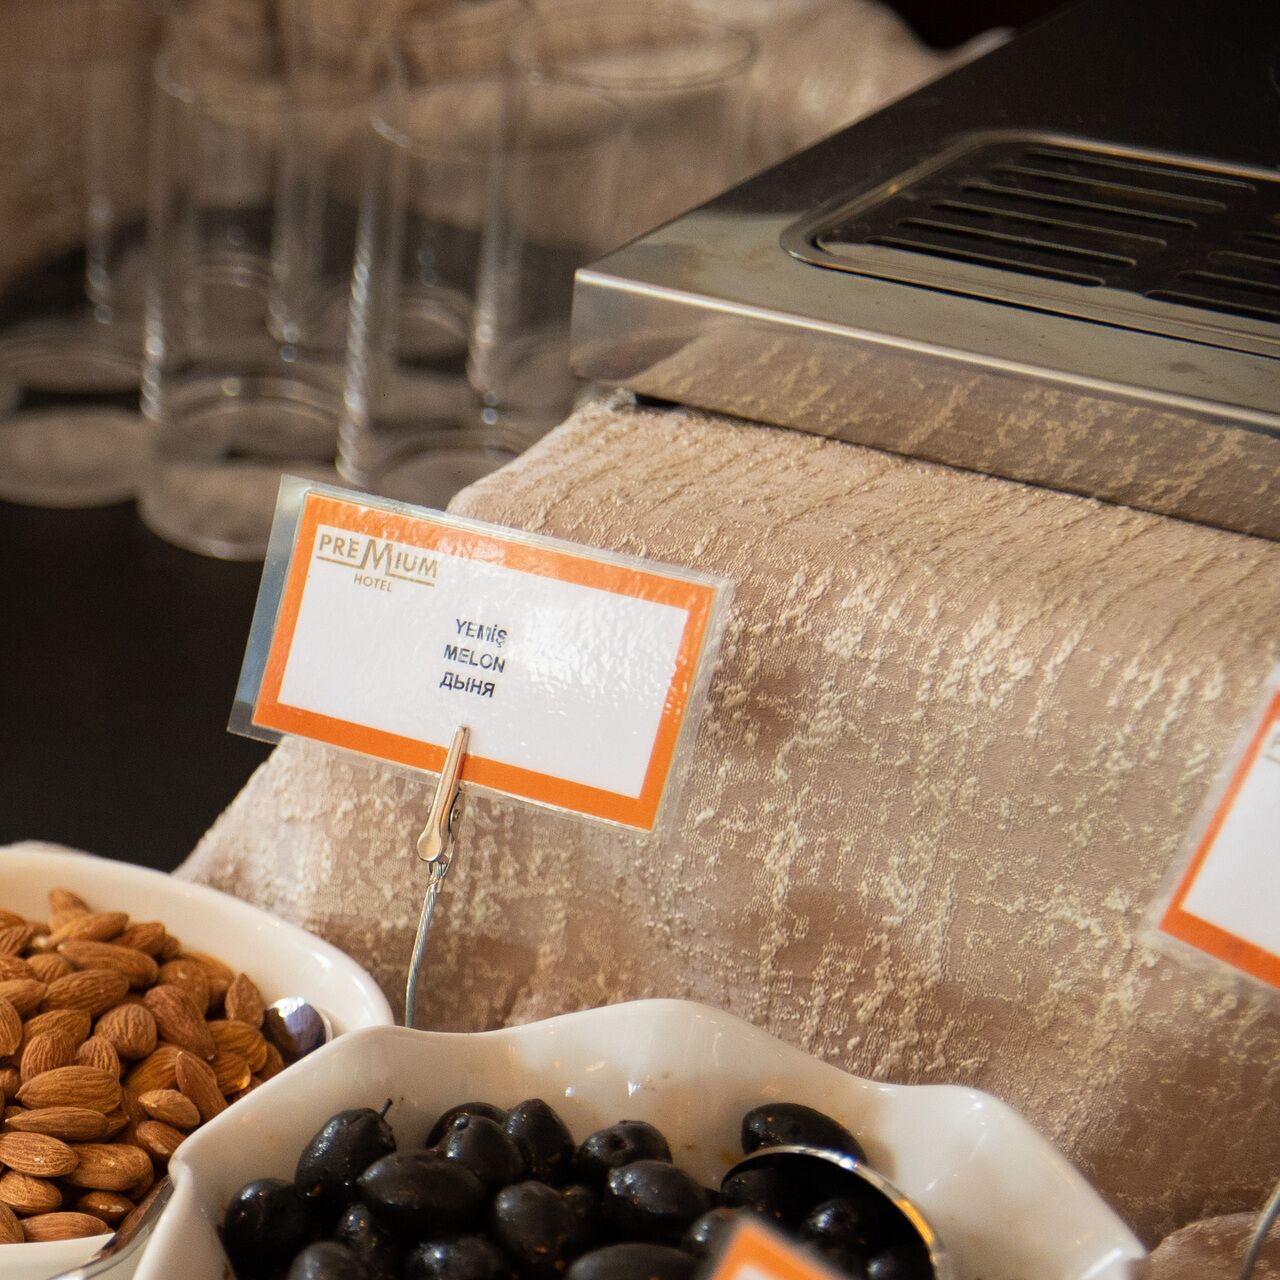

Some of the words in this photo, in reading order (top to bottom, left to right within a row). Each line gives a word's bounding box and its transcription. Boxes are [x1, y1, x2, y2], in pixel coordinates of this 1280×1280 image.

[319, 533, 439, 579] PREMIUM
[354, 573, 393, 593] HOTEL
[455, 618, 508, 648] YEMİŞ
[443, 644, 506, 673] MELON
[439, 671, 496, 698] ДЫНЯ
